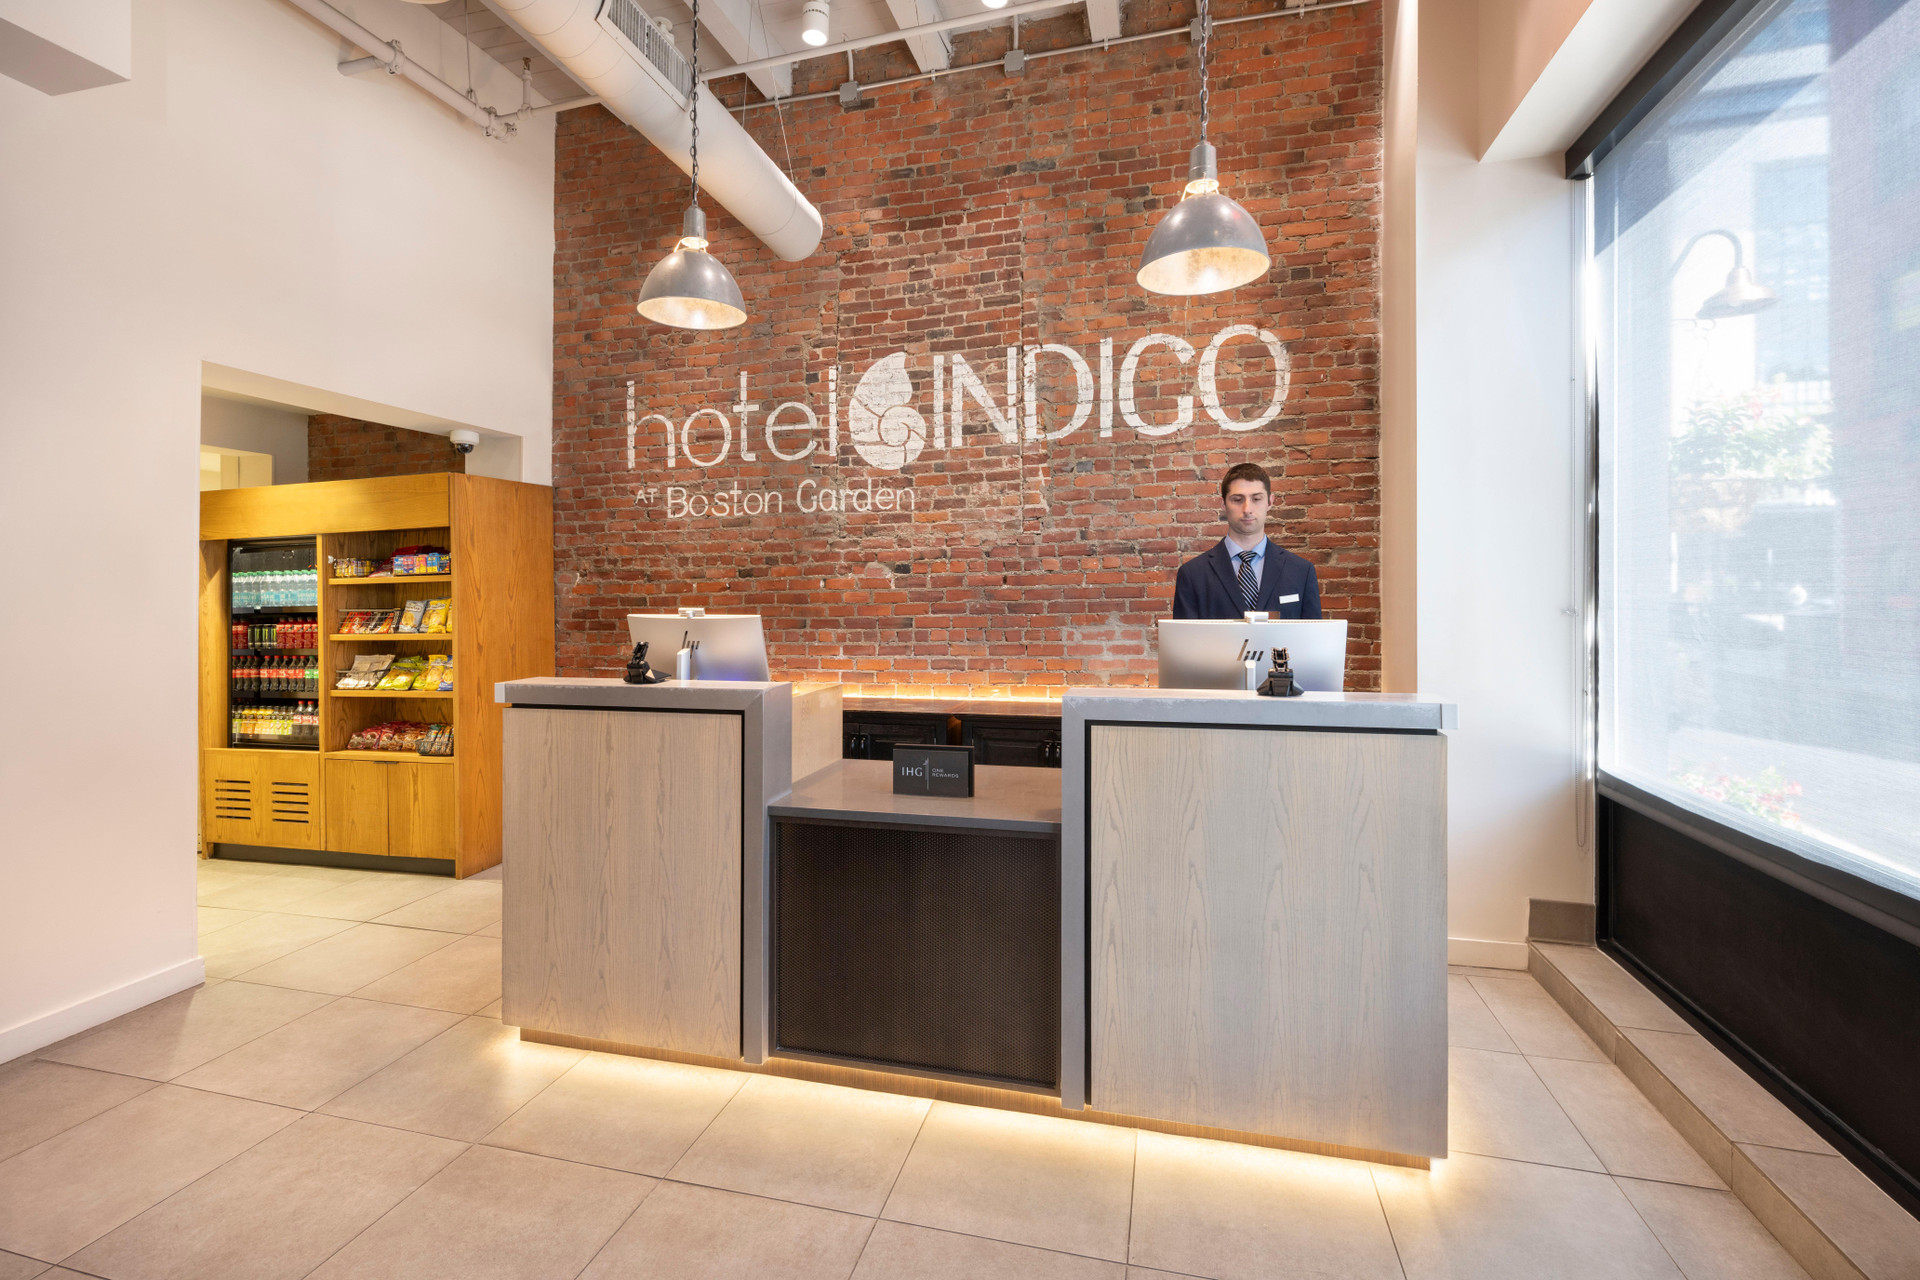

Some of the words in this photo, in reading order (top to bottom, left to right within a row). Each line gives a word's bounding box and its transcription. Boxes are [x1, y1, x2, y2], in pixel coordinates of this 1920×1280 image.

[626, 366, 837, 469] hotel
[933, 324, 1291, 450] INDIGO
[635, 487, 658, 504] AT
[666, 481, 782, 519] Boston
[796, 477, 916, 514] Garden
[901, 766, 923, 777] IHG
